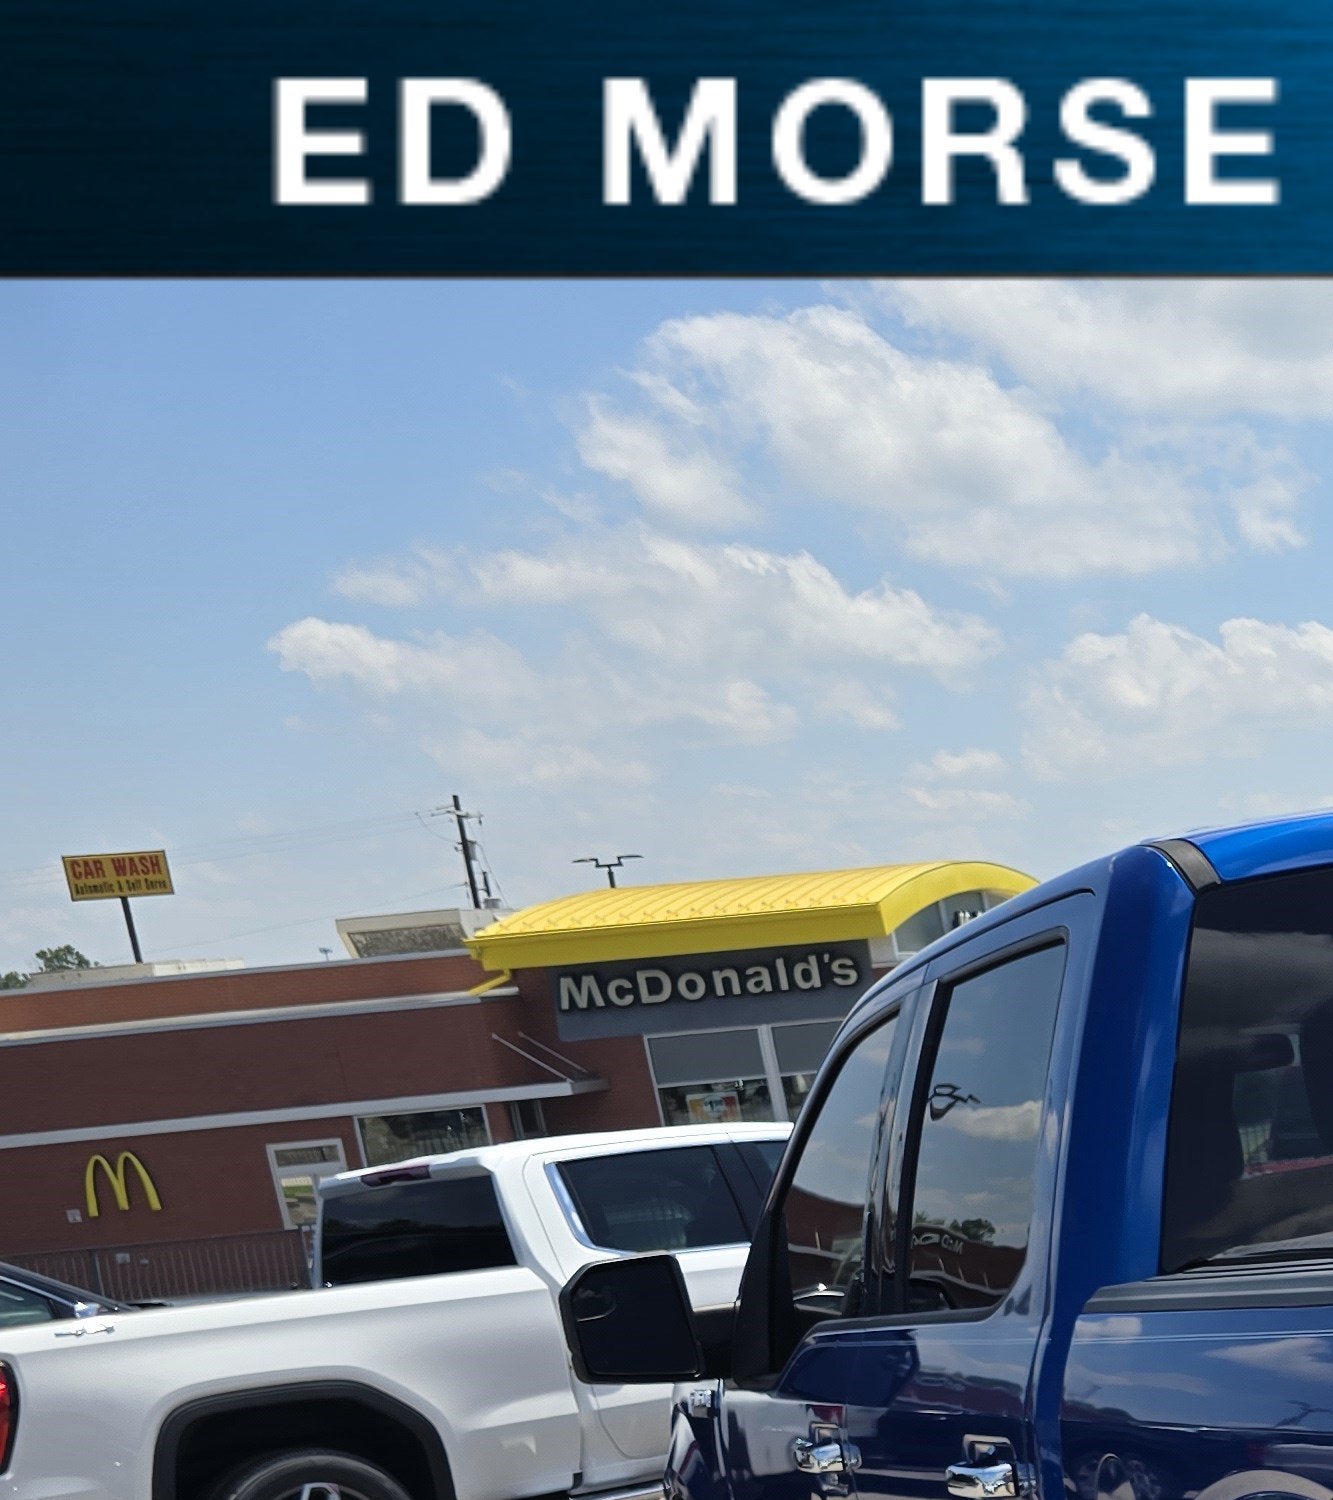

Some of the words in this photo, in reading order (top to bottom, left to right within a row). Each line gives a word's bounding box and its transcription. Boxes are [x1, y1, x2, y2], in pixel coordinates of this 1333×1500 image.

[70, 859, 107, 881] CAR
[111, 855, 164, 877] WASH
[558, 952, 860, 1012] McDonald's
